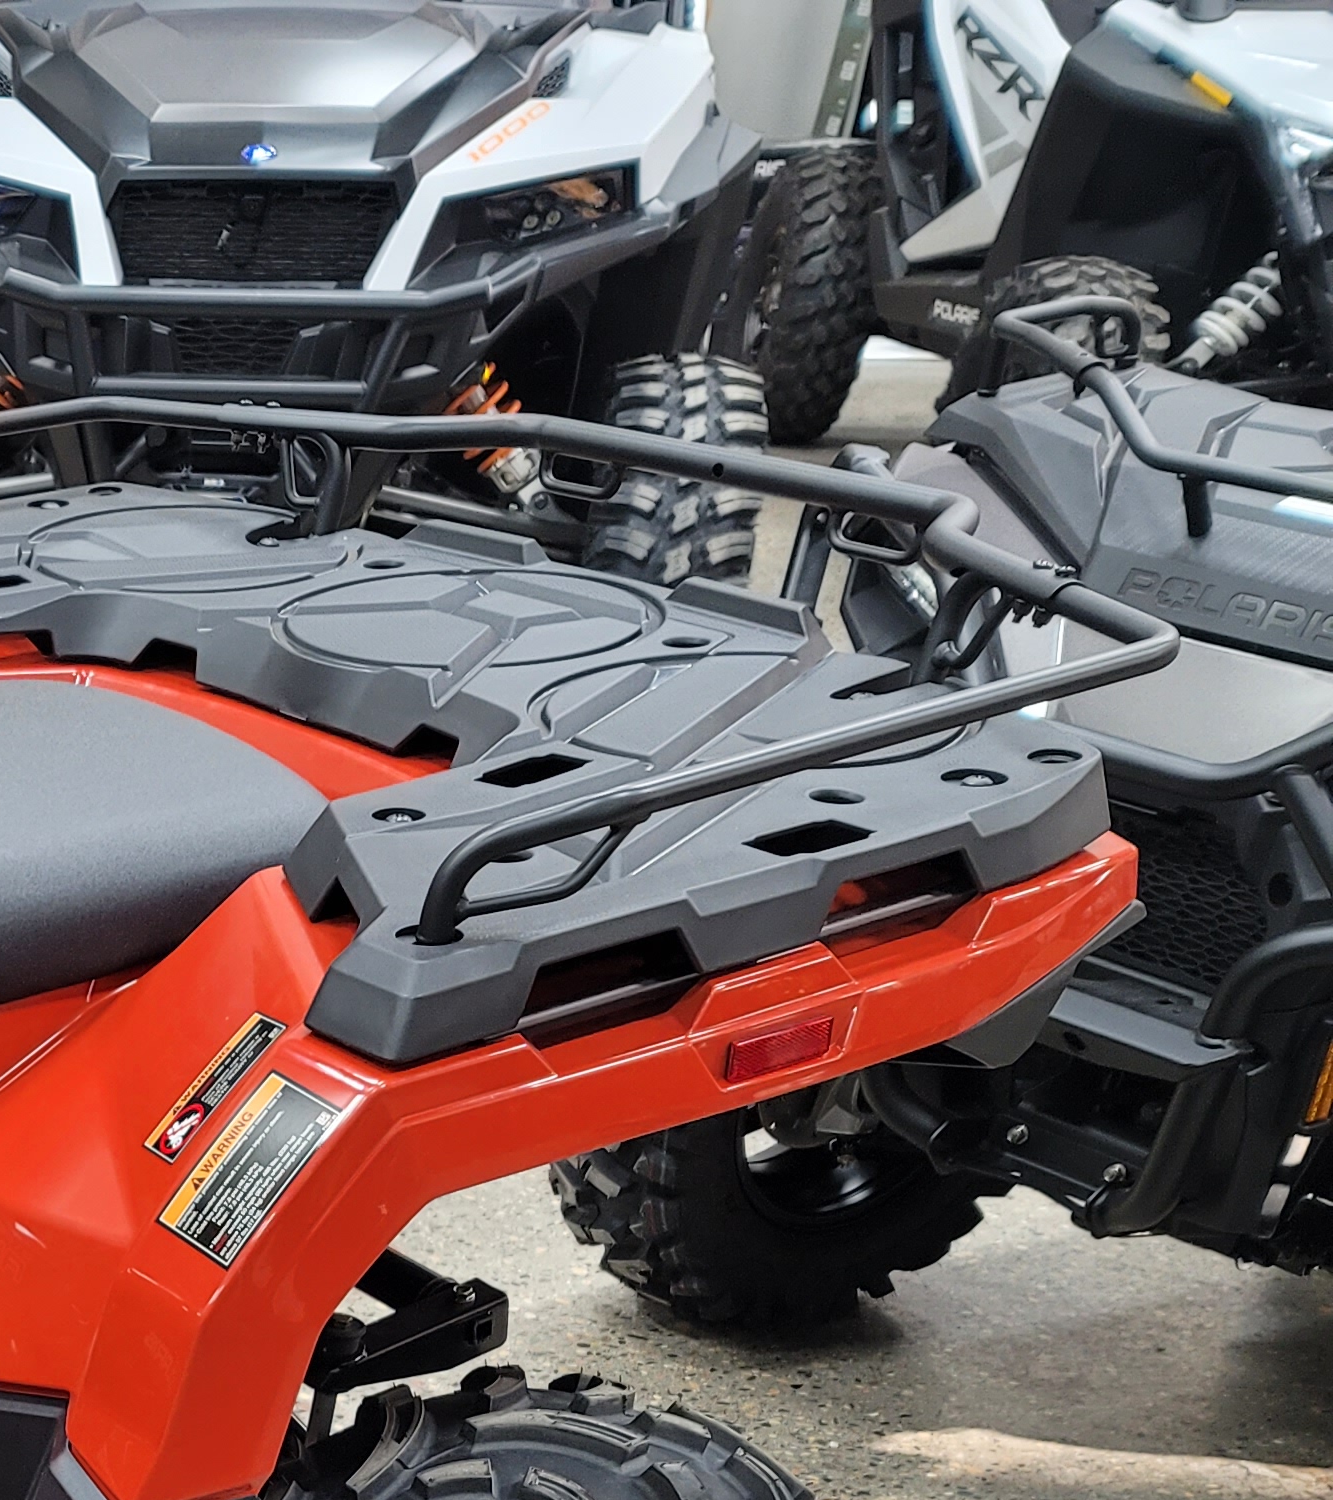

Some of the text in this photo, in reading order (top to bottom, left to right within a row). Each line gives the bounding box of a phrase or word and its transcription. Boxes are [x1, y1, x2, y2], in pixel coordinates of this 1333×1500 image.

[957, 5, 1046, 122] RZR
[468, 101, 551, 162] 1000
[181, 1045, 231, 1103] WARNING
[201, 1111, 254, 1174] WARNING
